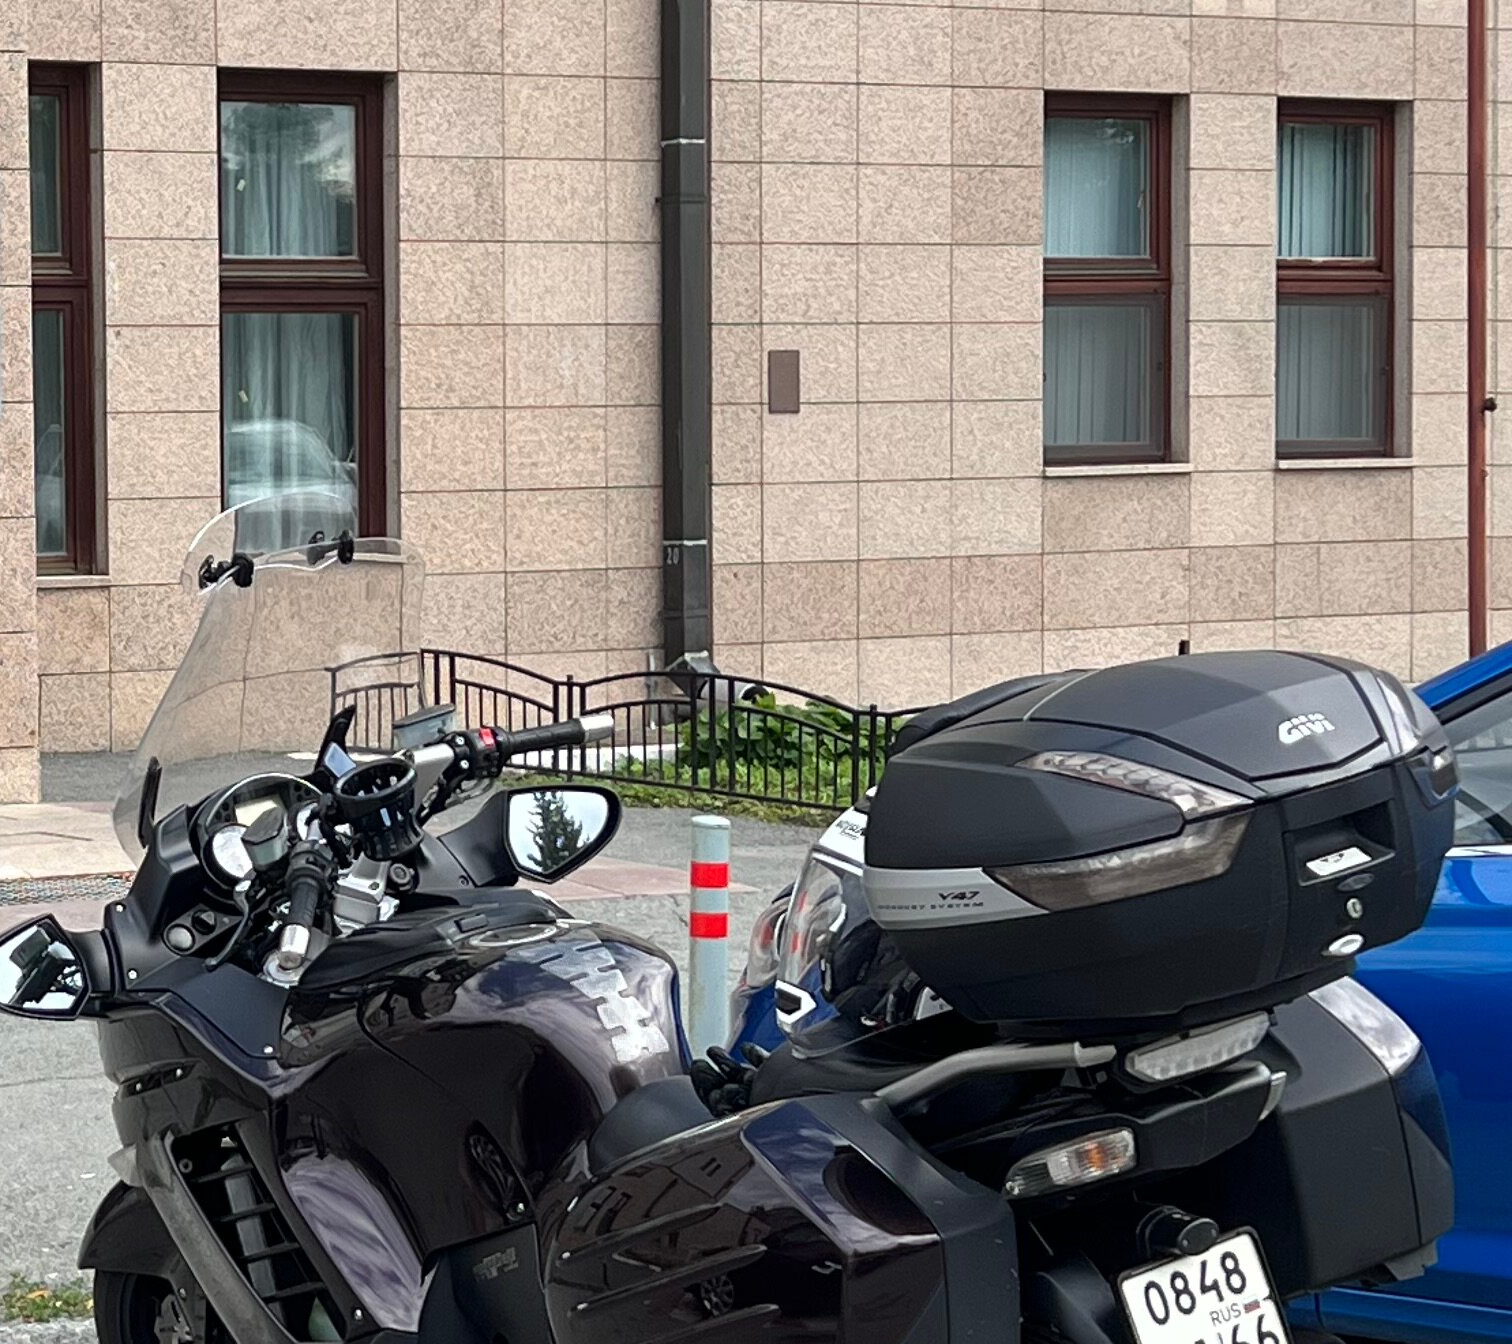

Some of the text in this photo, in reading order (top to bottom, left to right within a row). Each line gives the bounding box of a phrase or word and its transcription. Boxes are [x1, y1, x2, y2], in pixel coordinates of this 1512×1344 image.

[1278, 713, 1335, 744] GIVI
[938, 890, 980, 901] V47
[1144, 1251, 1246, 1326] 0848
[1209, 1302, 1242, 1327] RUS
